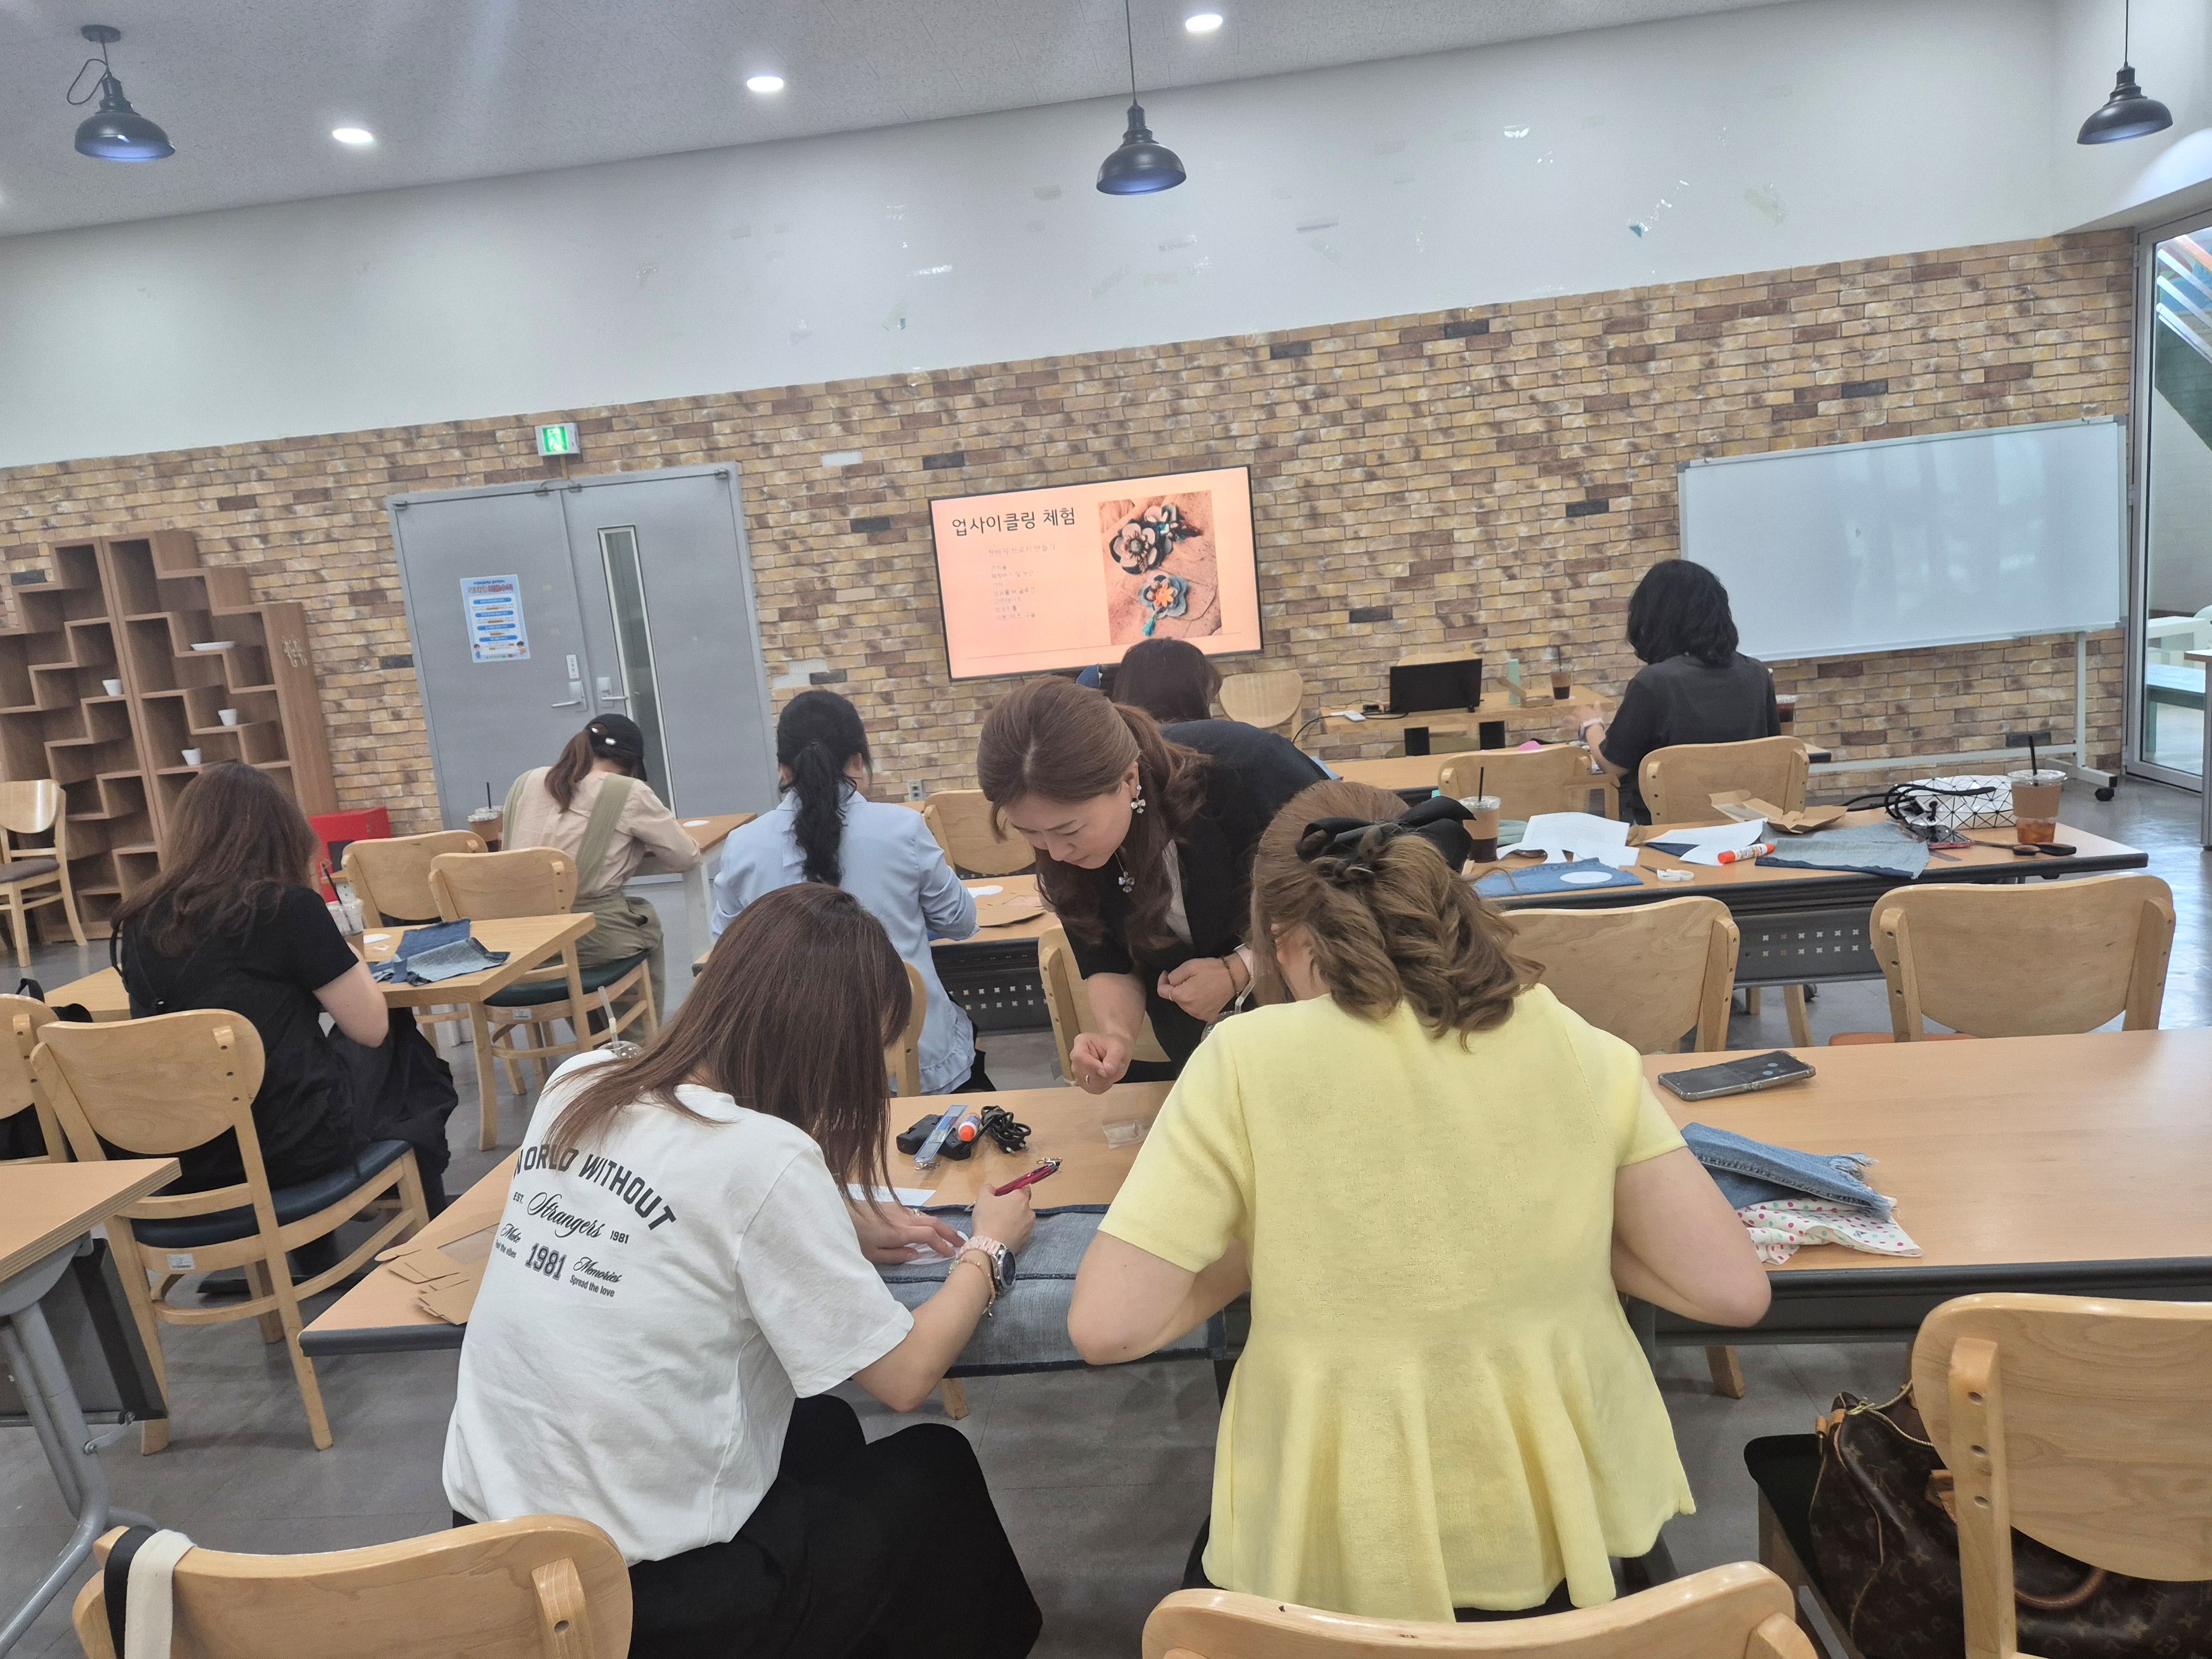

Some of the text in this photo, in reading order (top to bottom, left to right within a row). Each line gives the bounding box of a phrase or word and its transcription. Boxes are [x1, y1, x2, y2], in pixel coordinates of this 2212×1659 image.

[952, 507, 1075, 536] 업사이클링 체험
[1034, 543, 1055, 552] 만들기
[578, 1154, 677, 1230] WITHOUT
[513, 1192, 629, 1244] EST. Strangers 1981
[525, 1243, 567, 1281] 1981
[573, 1256, 623, 1282] Memories
[570, 1275, 615, 1297] Spread the love
